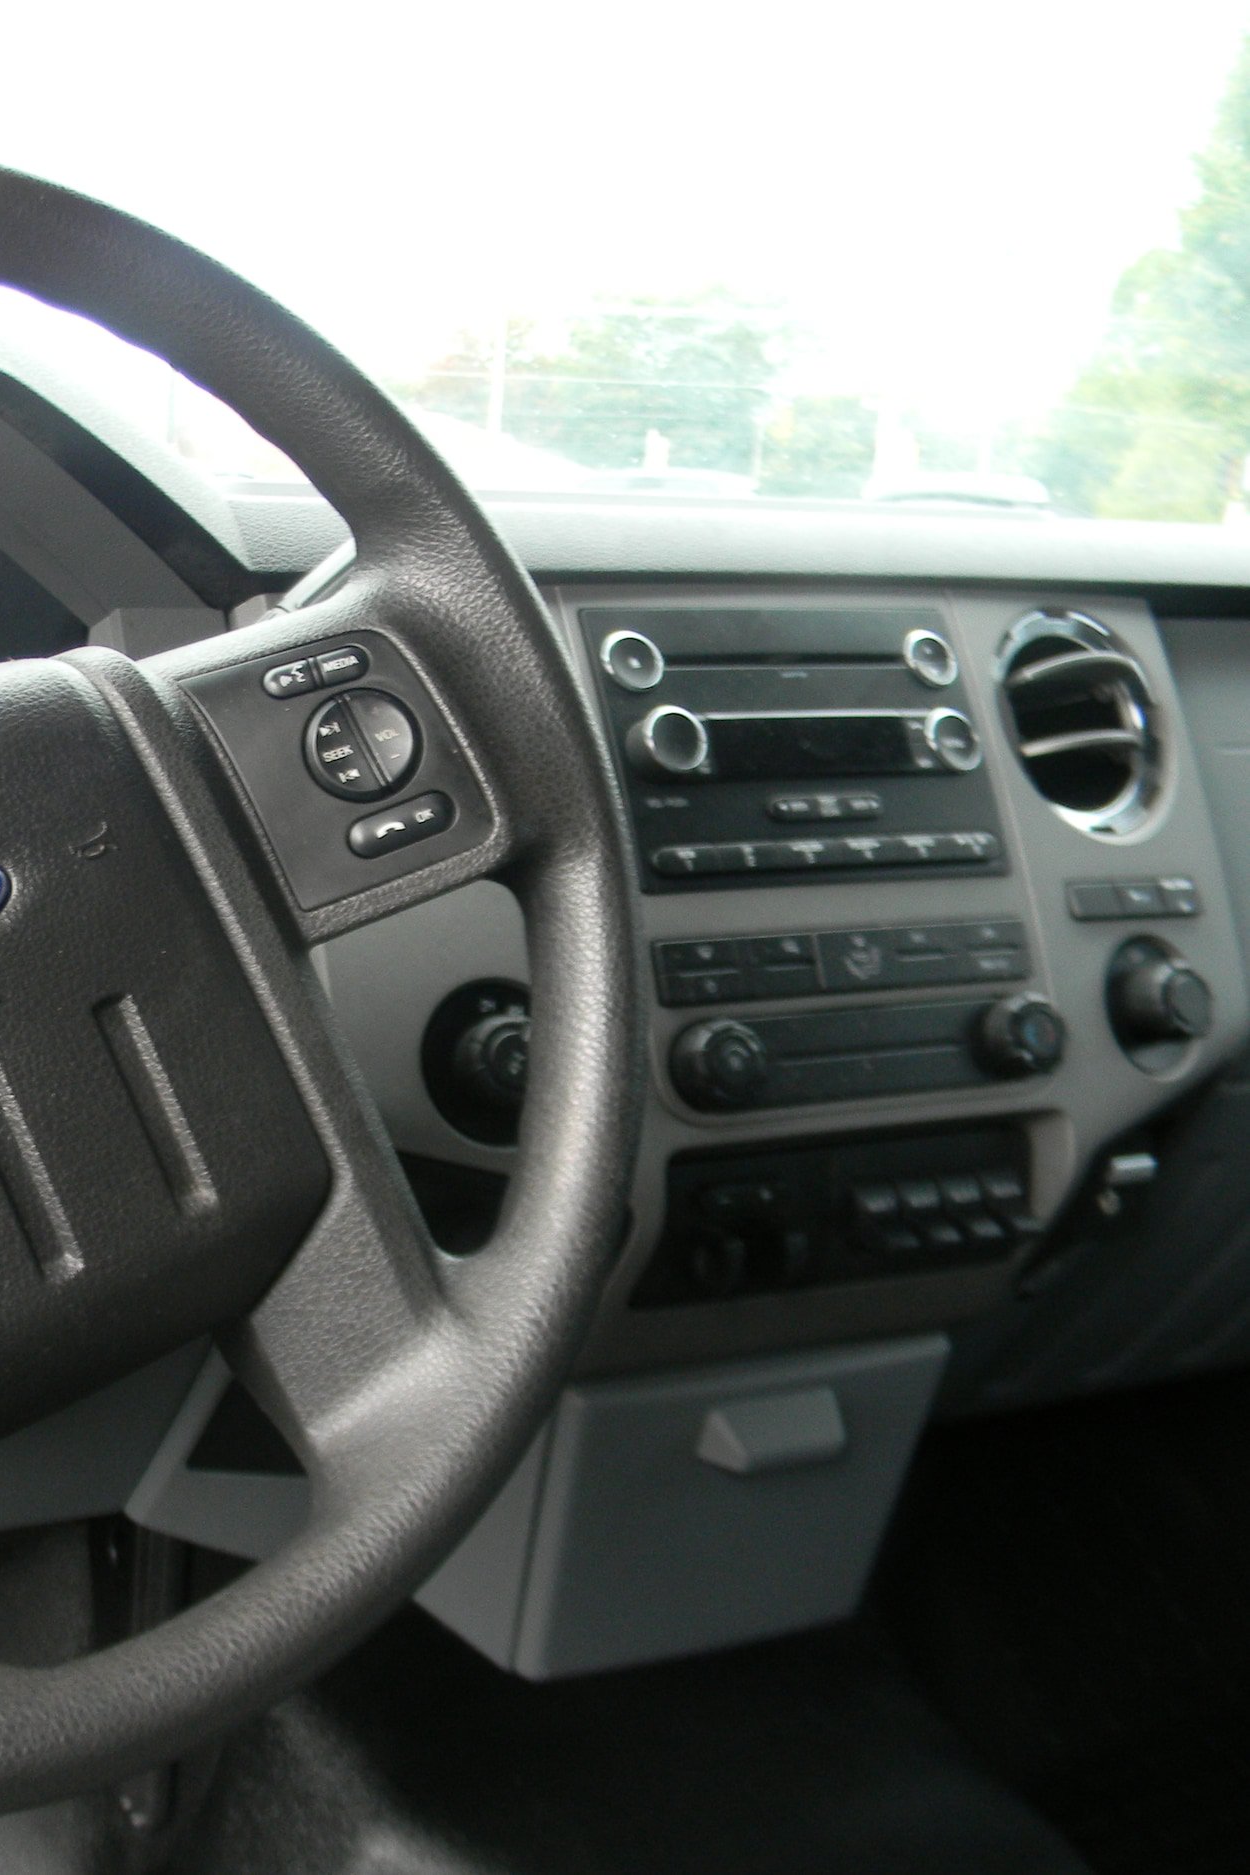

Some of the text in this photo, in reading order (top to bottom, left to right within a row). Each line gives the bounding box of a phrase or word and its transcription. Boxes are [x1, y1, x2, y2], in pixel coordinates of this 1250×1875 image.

[322, 656, 360, 672] MEDIA
[375, 729, 400, 742] VOL
[323, 745, 353, 762] SEEK
[415, 808, 435, 823] OK
